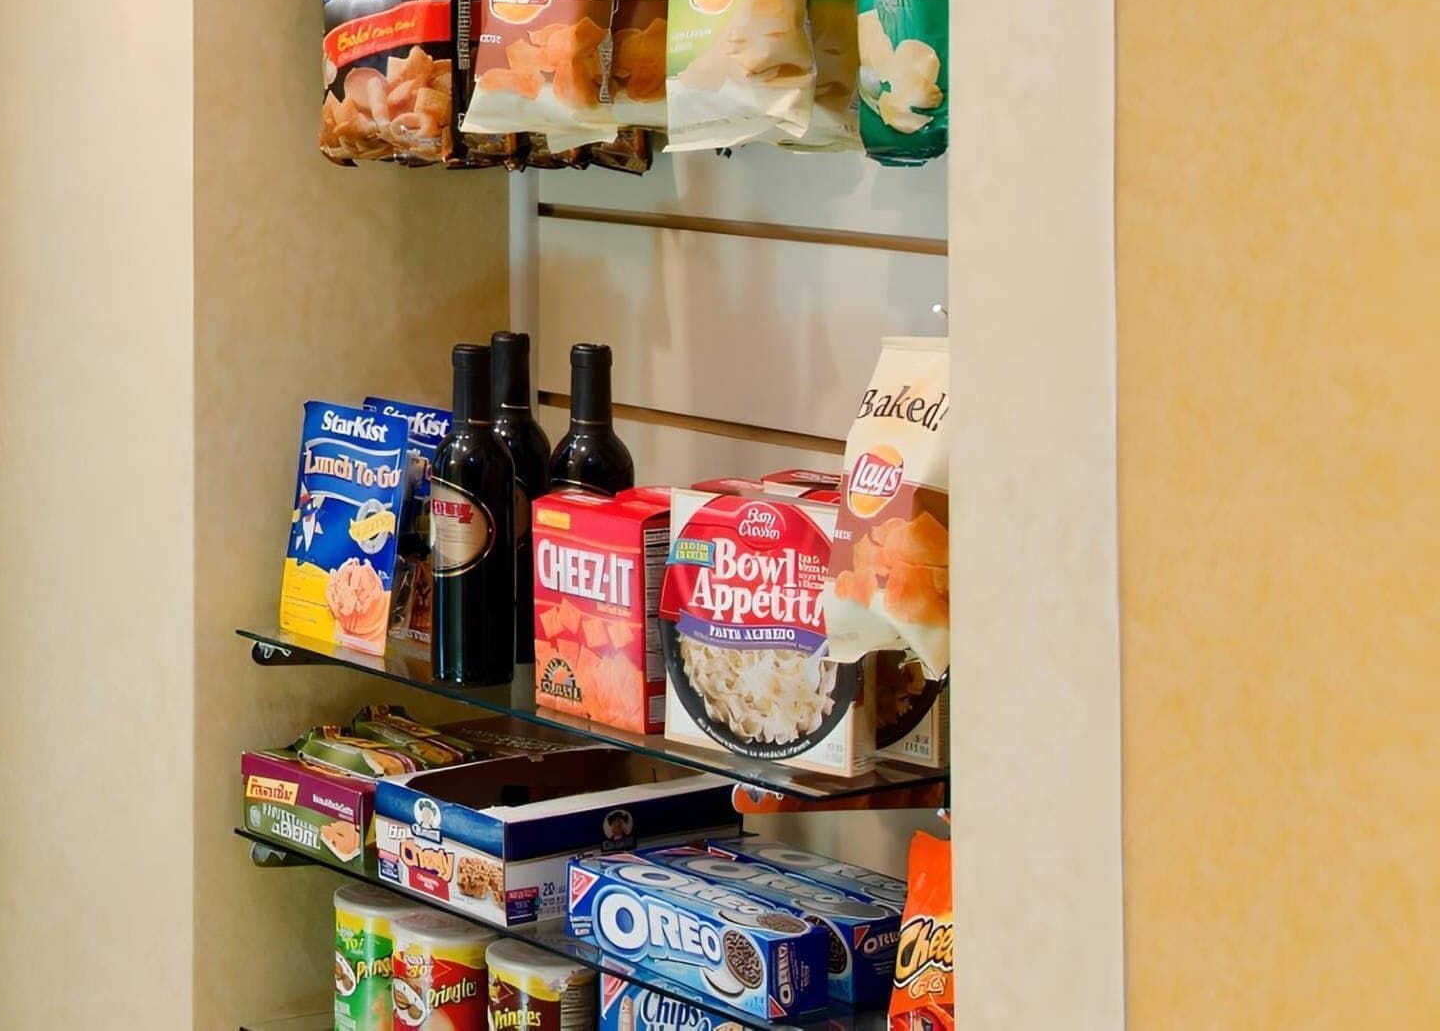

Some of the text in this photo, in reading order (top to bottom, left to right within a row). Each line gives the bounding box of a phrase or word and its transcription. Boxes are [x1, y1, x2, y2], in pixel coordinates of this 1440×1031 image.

[321, 410, 389, 443] StarKist
[304, 449, 353, 482] Lunch
[850, 454, 903, 498] Lay's
[537, 538, 635, 608] CHEEZ-IT
[711, 537, 798, 589] Bowl
[687, 567, 826, 627] Appétit!
[598, 892, 723, 963] OREO
